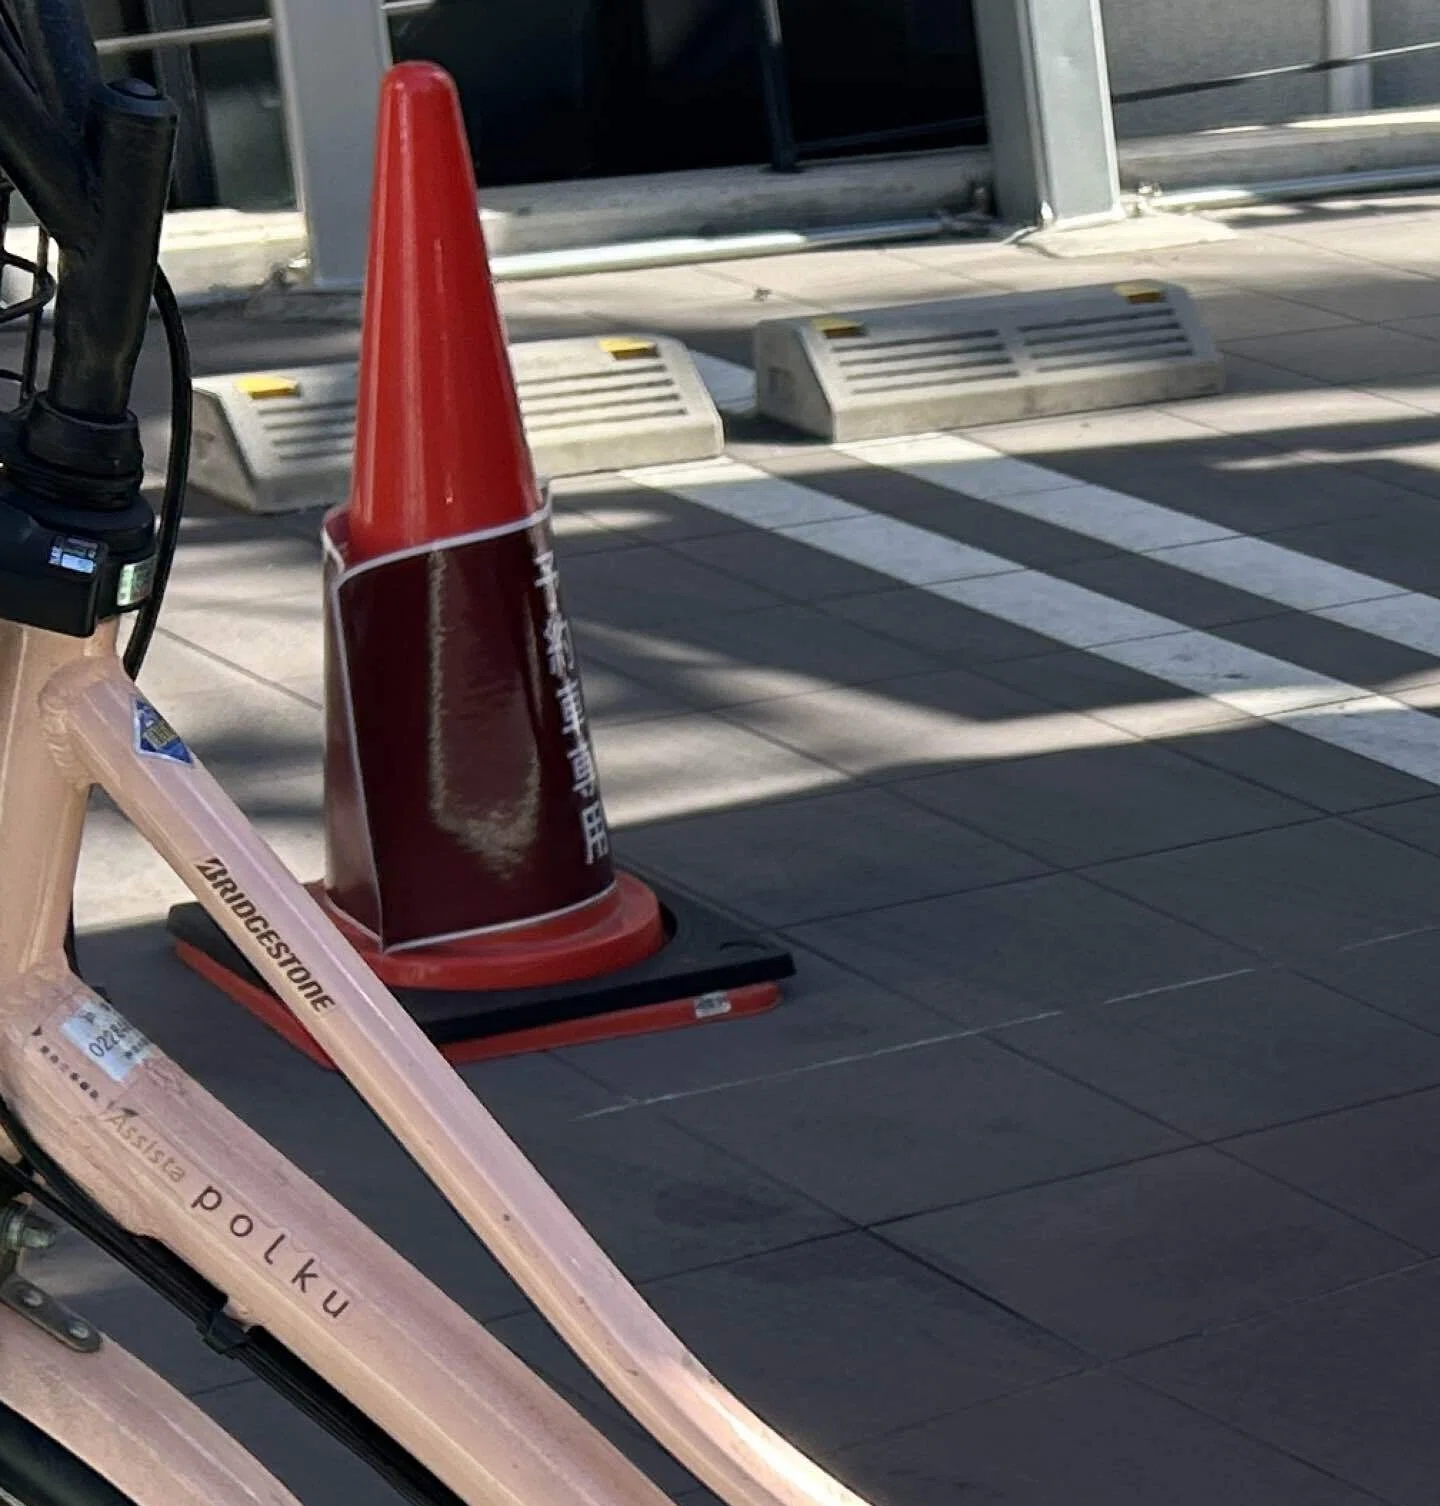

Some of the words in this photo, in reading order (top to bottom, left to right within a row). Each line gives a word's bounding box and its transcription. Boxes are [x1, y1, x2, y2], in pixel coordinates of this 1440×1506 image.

[196, 856, 335, 1014] BRIDGESTONE
[108, 1108, 186, 1184] Assista
[190, 1185, 350, 1319] polku
